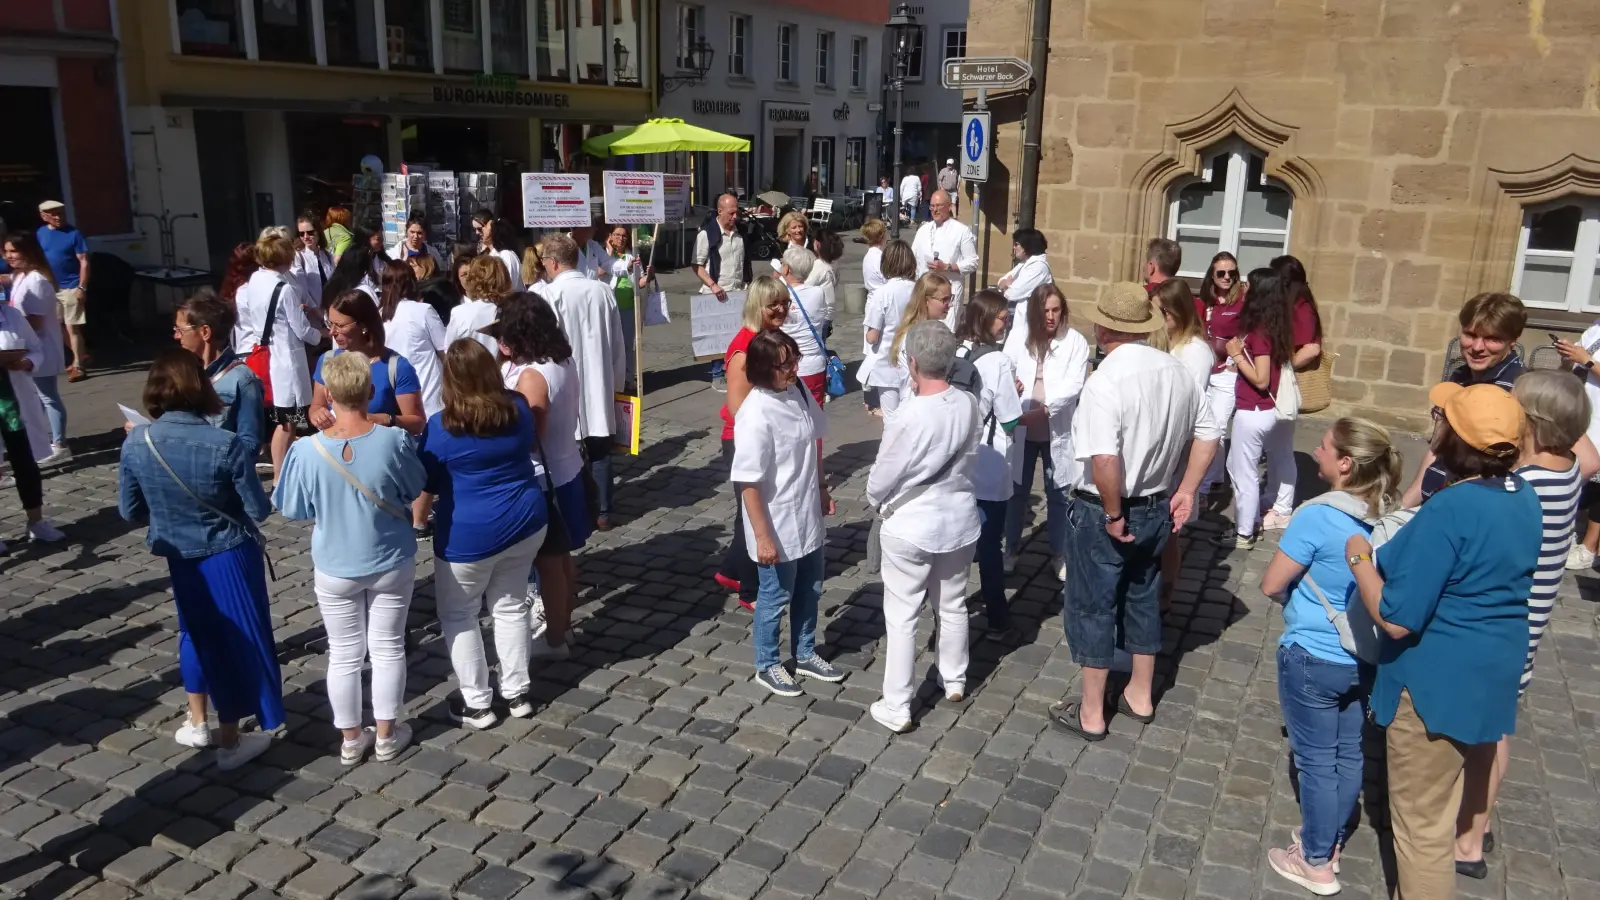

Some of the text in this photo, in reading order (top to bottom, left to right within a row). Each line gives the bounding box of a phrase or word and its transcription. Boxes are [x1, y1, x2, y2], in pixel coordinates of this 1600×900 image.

[976, 65, 999, 73] Hotel
[962, 73, 996, 81] Schwarzer
[966, 164, 981, 176] ZONE
